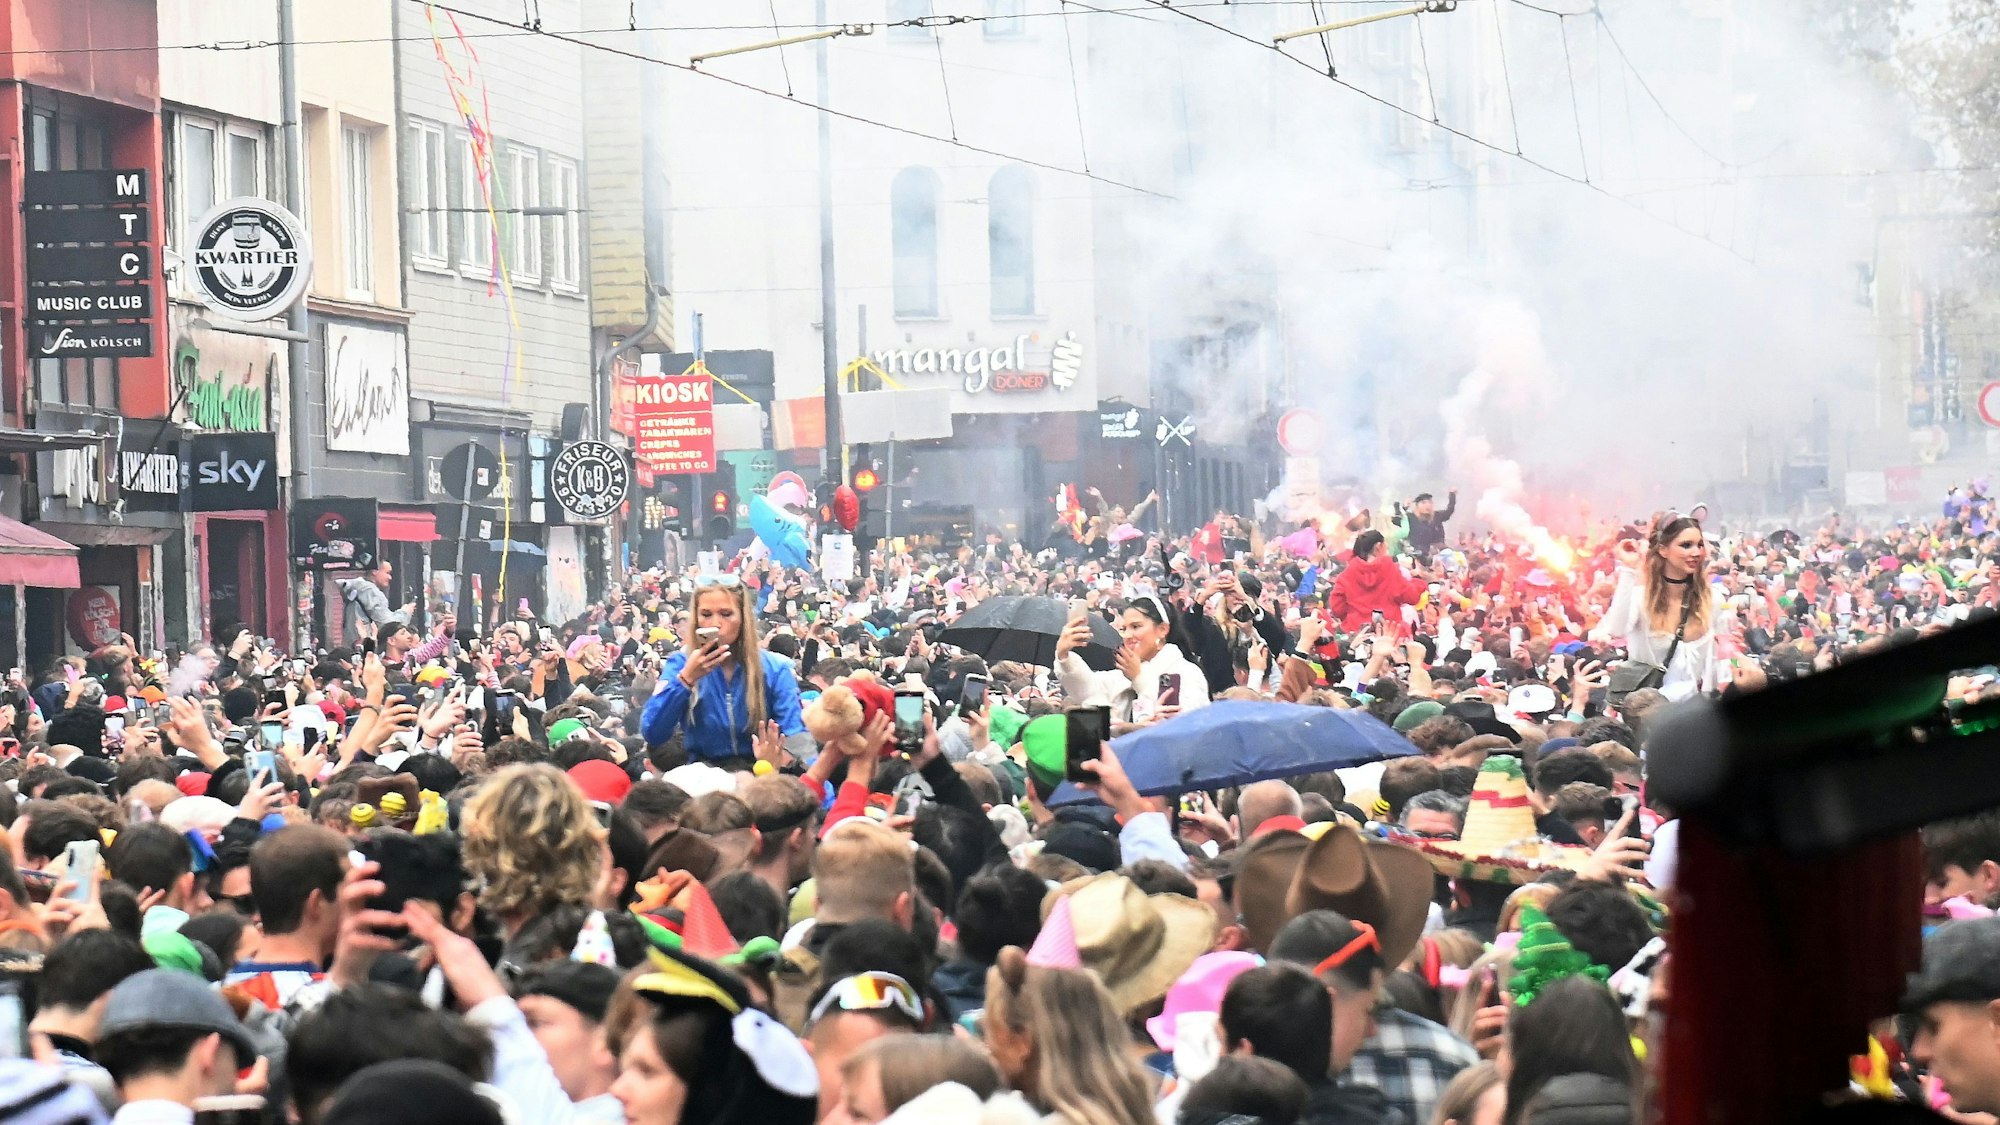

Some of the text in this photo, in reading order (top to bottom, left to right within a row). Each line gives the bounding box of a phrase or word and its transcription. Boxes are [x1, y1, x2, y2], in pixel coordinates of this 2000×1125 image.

[195, 250, 298, 265] KWARTIER
[37, 296, 143, 311] MUSIC CLUB
[41, 328, 142, 354] Sion KÖLSCH
[874, 334, 1029, 393] mangal
[636, 382, 710, 404] KIOSK
[640, 427, 712, 438] TABAKWAREN
[557, 443, 622, 473] FRISEUR
[642, 450, 702, 460] ANDWICHES
[680, 461, 692, 470] TO
[694, 460, 708, 469] GO
[122, 451, 178, 494] KWARTIER
[199, 451, 266, 491] sky
[577, 465, 604, 493] K&B
